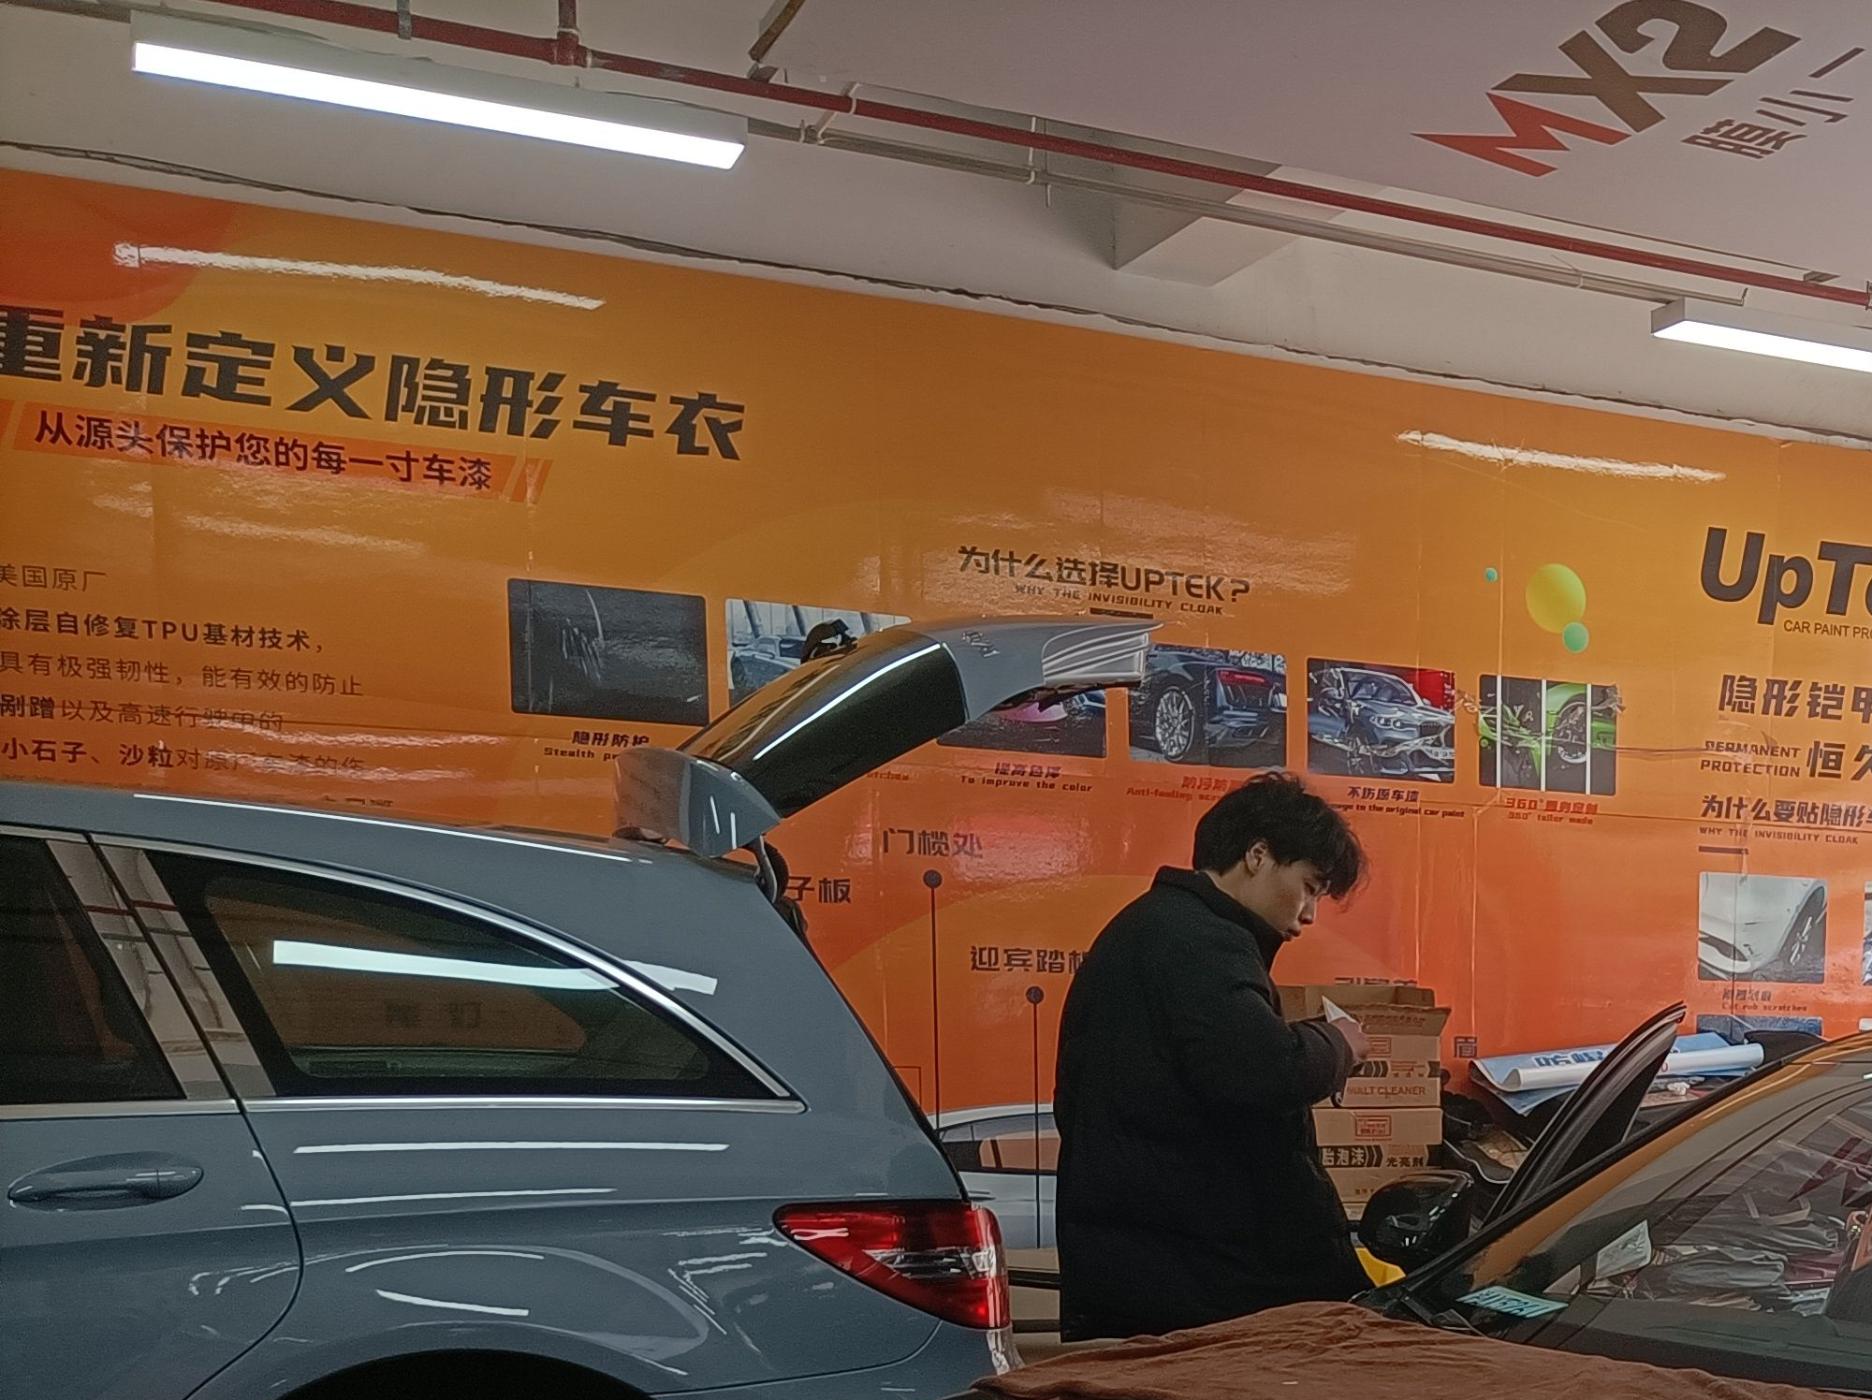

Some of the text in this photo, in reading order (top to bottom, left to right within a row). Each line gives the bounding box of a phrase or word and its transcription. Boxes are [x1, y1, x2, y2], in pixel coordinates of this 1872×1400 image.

[1410, 0, 1801, 177] MX2
[0, 305, 745, 461] 重新定义隐形车衣
[35, 410, 492, 491] 从源头保护您的每一寸车漆
[1054, 588, 1081, 601] THE
[1180, 602, 1223, 616] CLOAK
[1783, 619, 1811, 634] CAR
[1814, 622, 1850, 639] PAINT
[571, 730, 650, 748] 隐形防护
[543, 747, 595, 760] Stealth
[1704, 740, 1801, 758] PERMANENT
[1700, 759, 1801, 778] PROTECTION
[960, 775, 974, 785] To
[1036, 780, 1055, 790] the
[1062, 783, 1093, 793] color
[1369, 804, 1383, 812] the
[1424, 808, 1439, 816] car
[1699, 825, 1722, 836] WHY
[1728, 827, 1748, 838] THE
[1825, 834, 1859, 845] CLOAK
